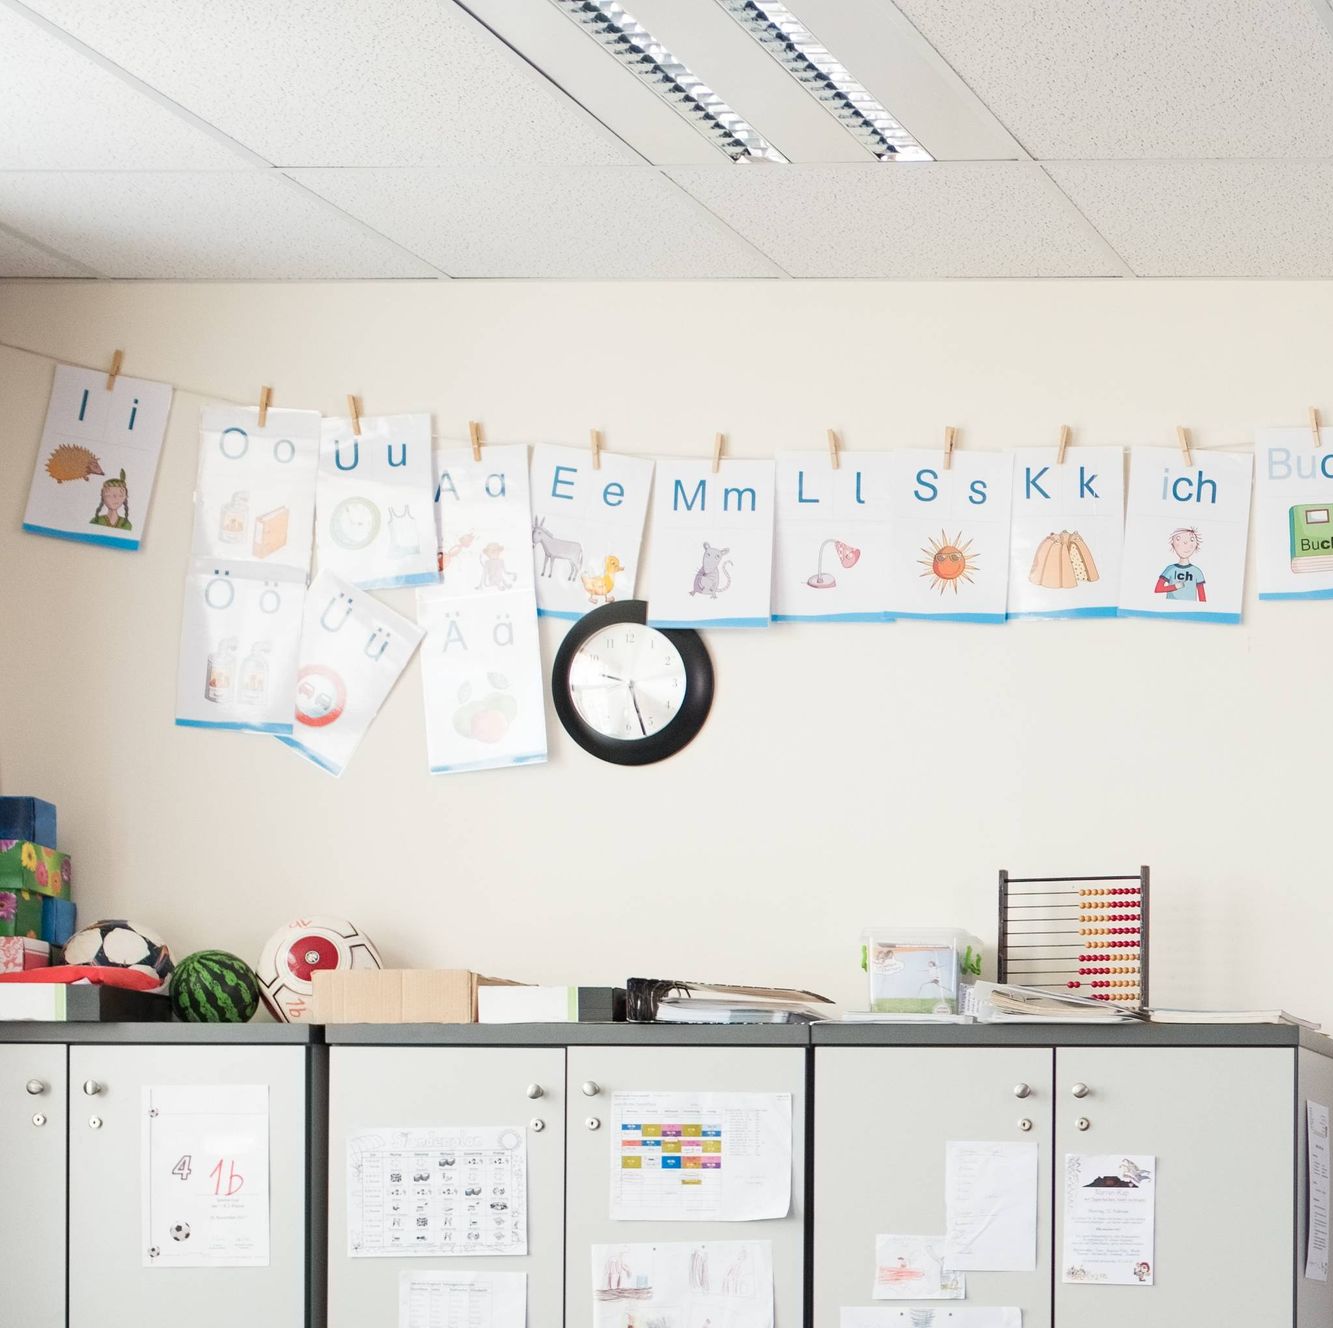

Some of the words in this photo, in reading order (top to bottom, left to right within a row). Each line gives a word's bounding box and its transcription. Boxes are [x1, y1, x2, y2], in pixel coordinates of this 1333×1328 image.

[78, 389, 89, 421] I
[128, 399, 138, 430] i
[335, 439, 359, 471] U
[388, 443, 406, 467] u
[551, 466, 577, 500] E
[602, 483, 625, 506] e
[673, 480, 706, 511] M
[723, 488, 756, 511] m
[798, 471, 820, 503] L
[856, 472, 865, 504] l
[914, 469, 939, 502] S
[968, 480, 987, 505] s
[1026, 467, 1051, 499] K
[1080, 467, 1099, 498] k
[1163, 468, 1217, 504] ich
[172, 1155, 192, 1180] 4
[209, 1159, 244, 1196] 1b
